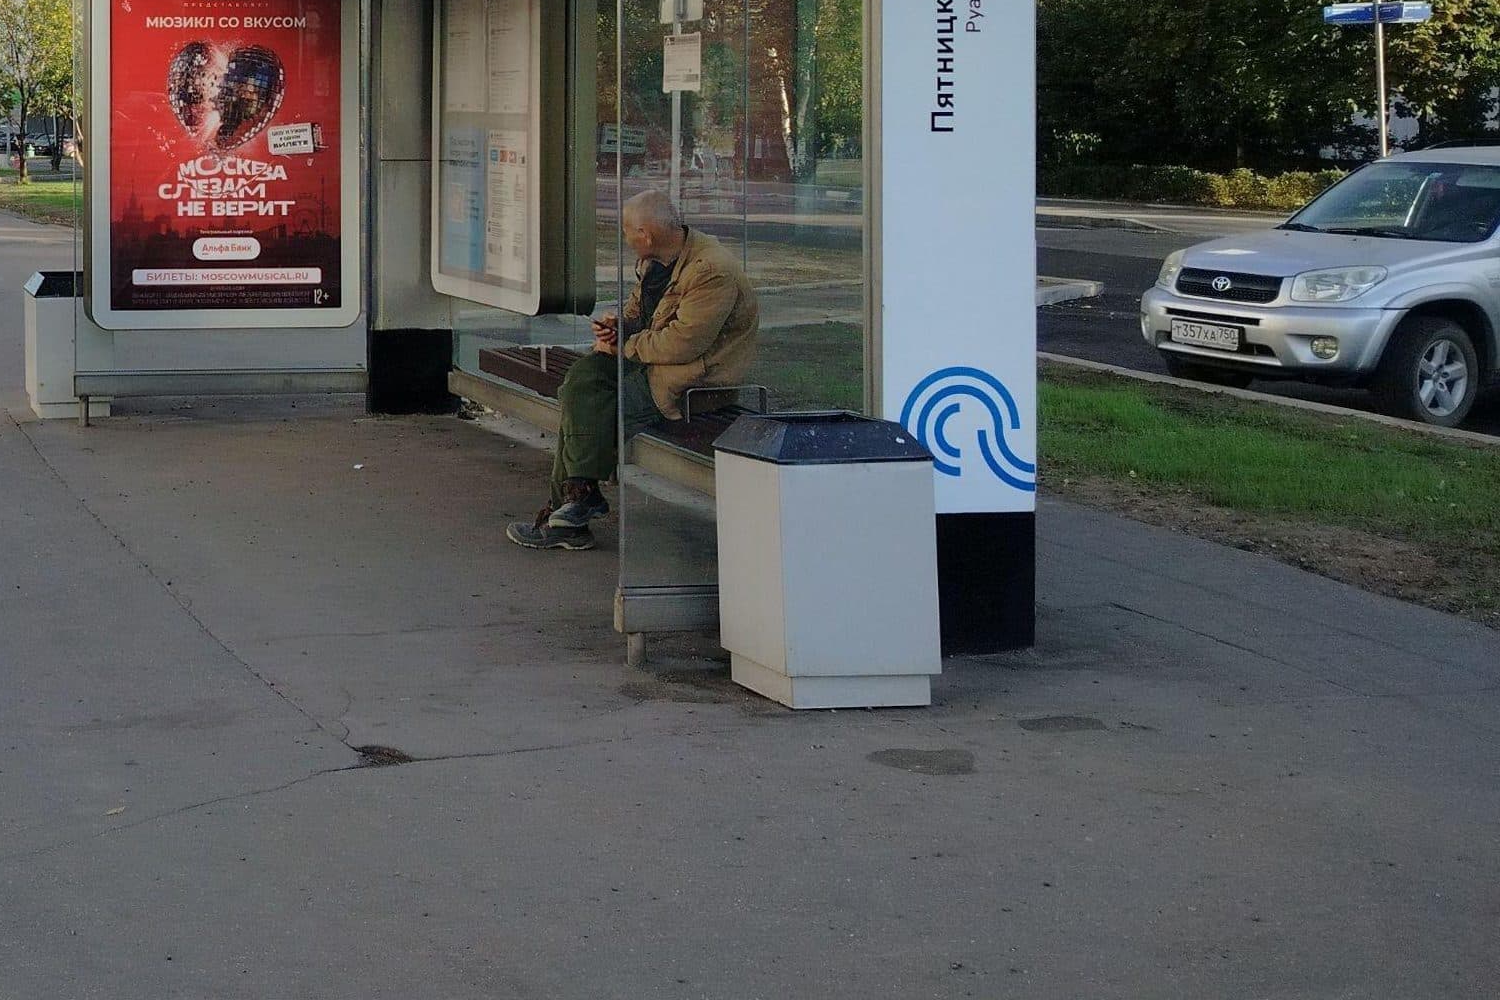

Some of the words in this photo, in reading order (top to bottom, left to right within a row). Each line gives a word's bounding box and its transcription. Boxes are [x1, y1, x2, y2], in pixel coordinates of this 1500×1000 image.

[146, 16, 215, 29] МЮЗИКЛ
[218, 16, 240, 29] СО
[243, 16, 307, 29] ВКУСОМ
[177, 154, 288, 182] МОСКВА
[158, 177, 266, 200] СЛЕЗАМ
[177, 202, 206, 217] НЕ
[212, 200, 296, 217] ВЕРИТ
[146, 273, 198, 281] БИЛЕТЫ:
[201, 272, 309, 281] MOSCOWMUSICAL.RU
[314, 289, 329, 304] 12+
